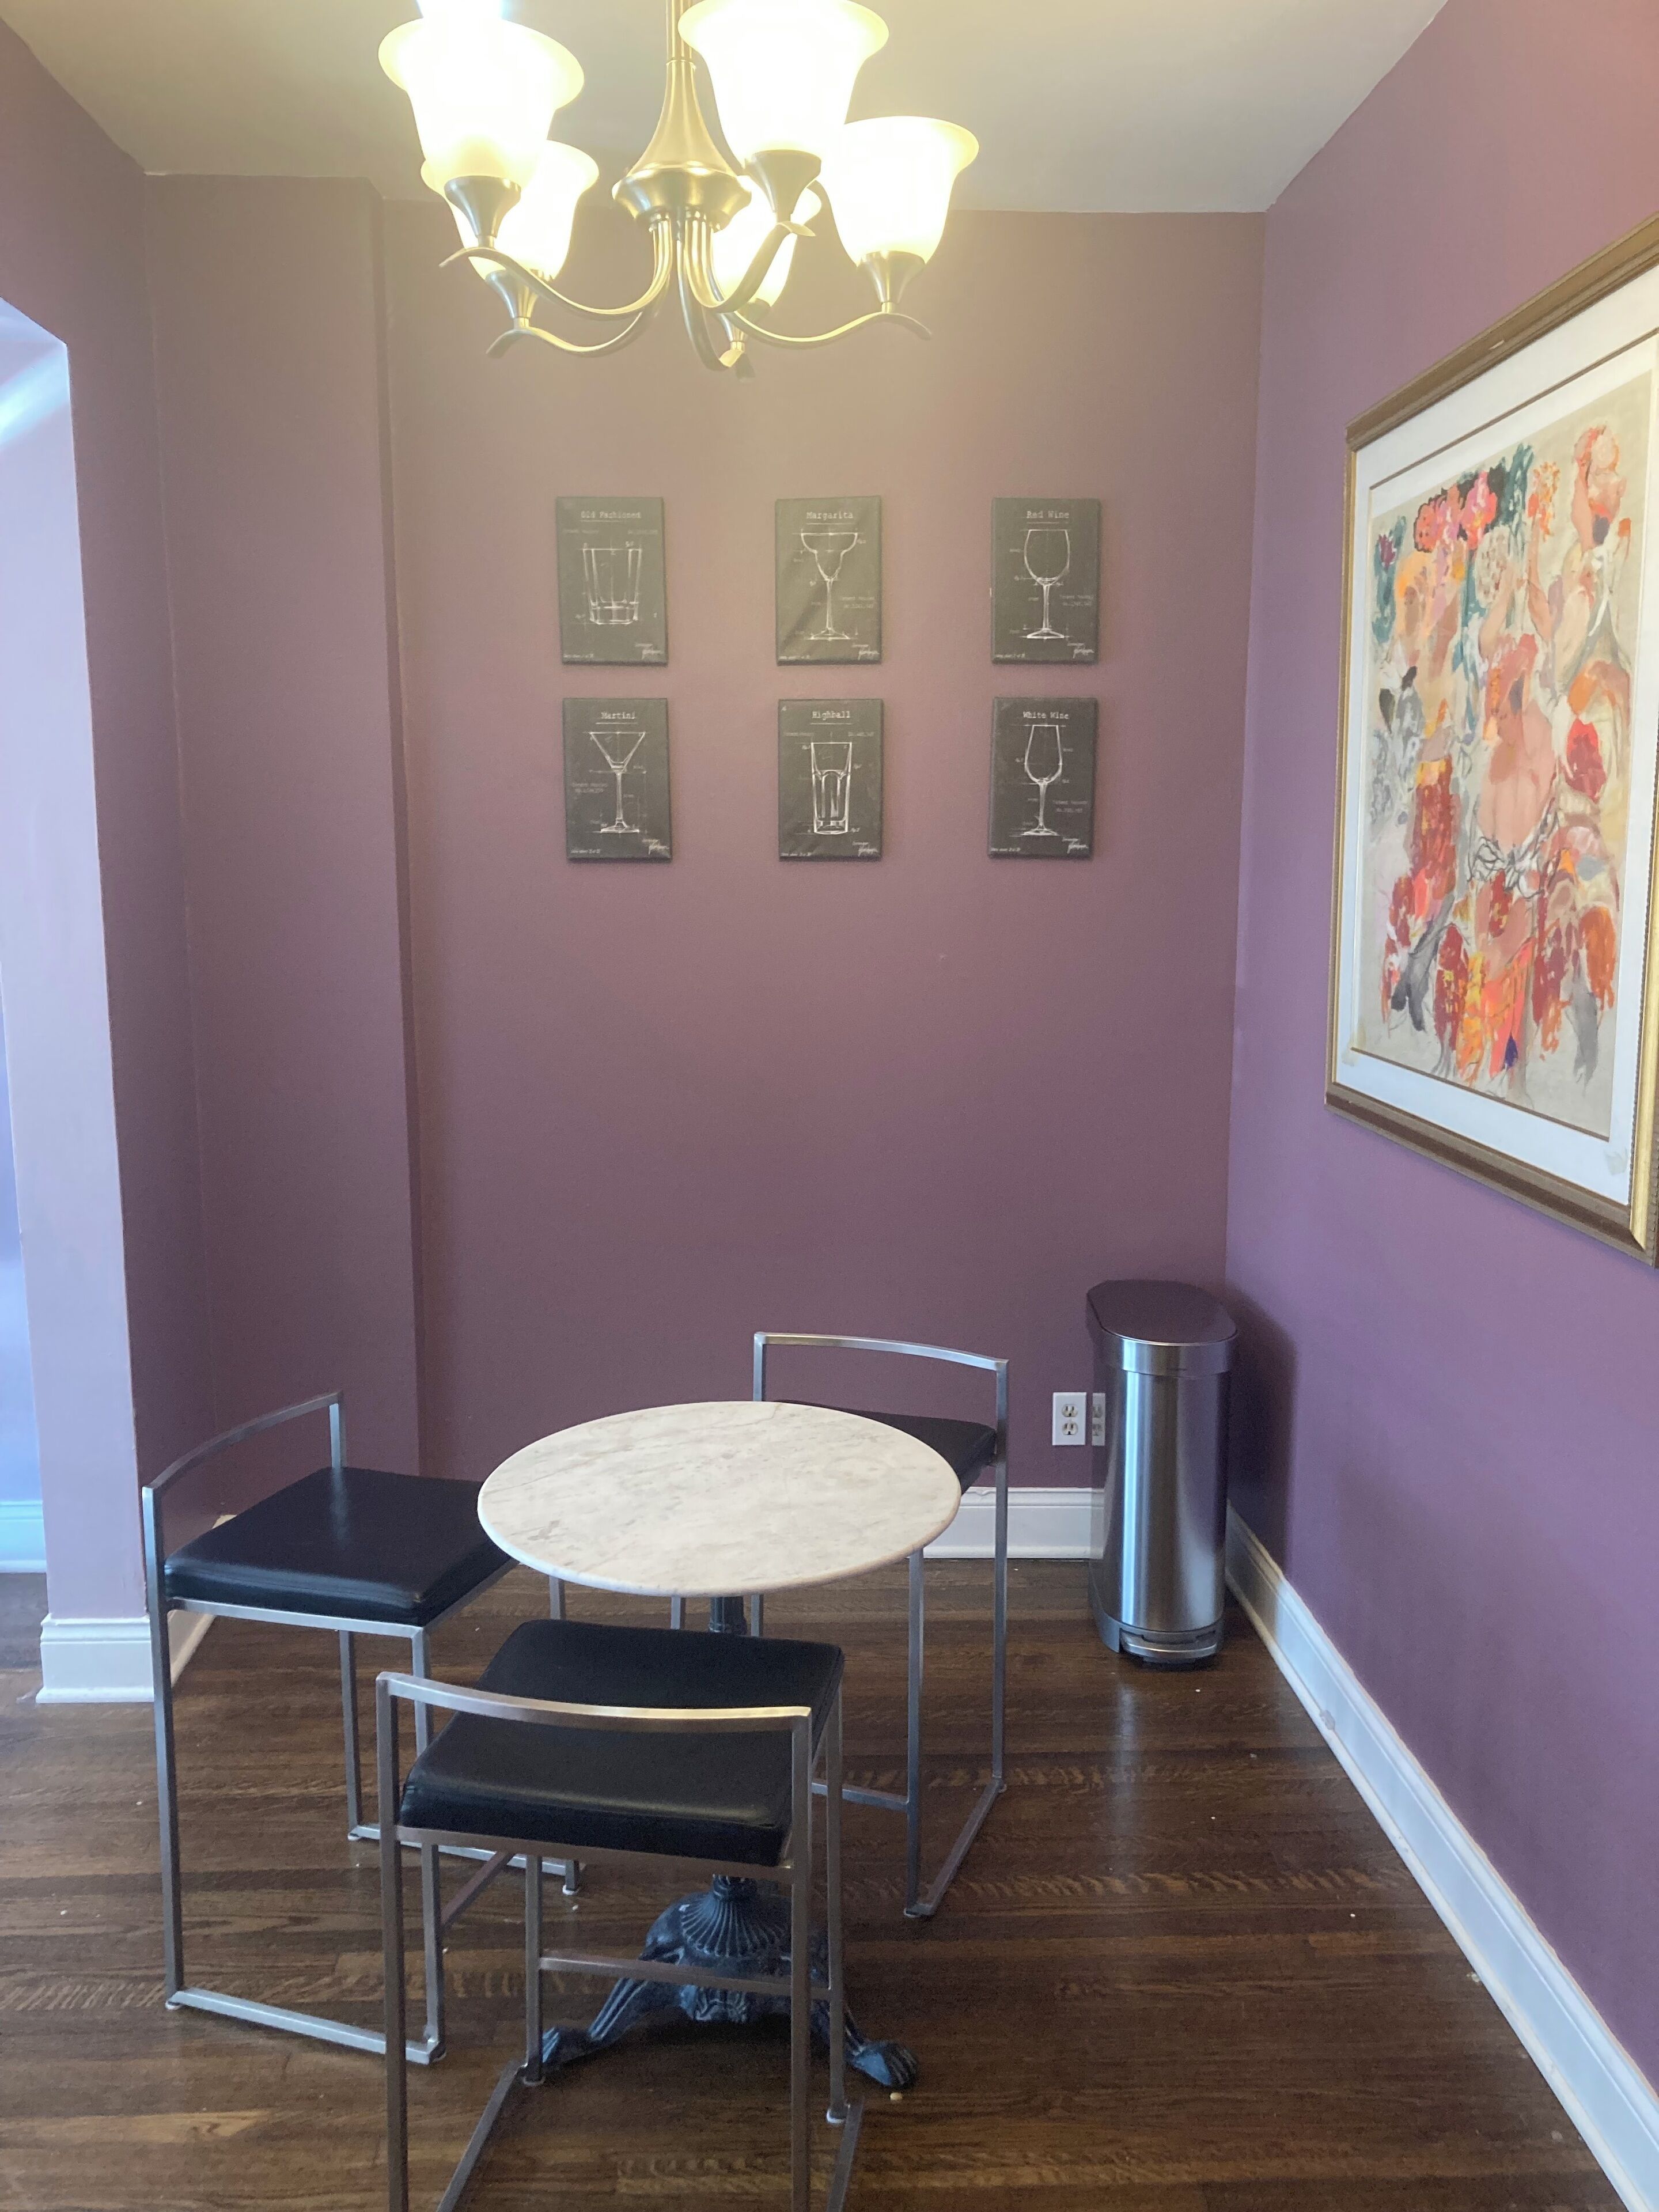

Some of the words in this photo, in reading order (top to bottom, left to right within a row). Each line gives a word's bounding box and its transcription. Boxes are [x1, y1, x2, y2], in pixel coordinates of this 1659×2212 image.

[806, 512, 853, 521] Margarita
[1027, 510, 1043, 518] Red
[1048, 510, 1069, 518] Wine
[601, 711, 635, 719] Martini
[812, 711, 850, 721] Highball
